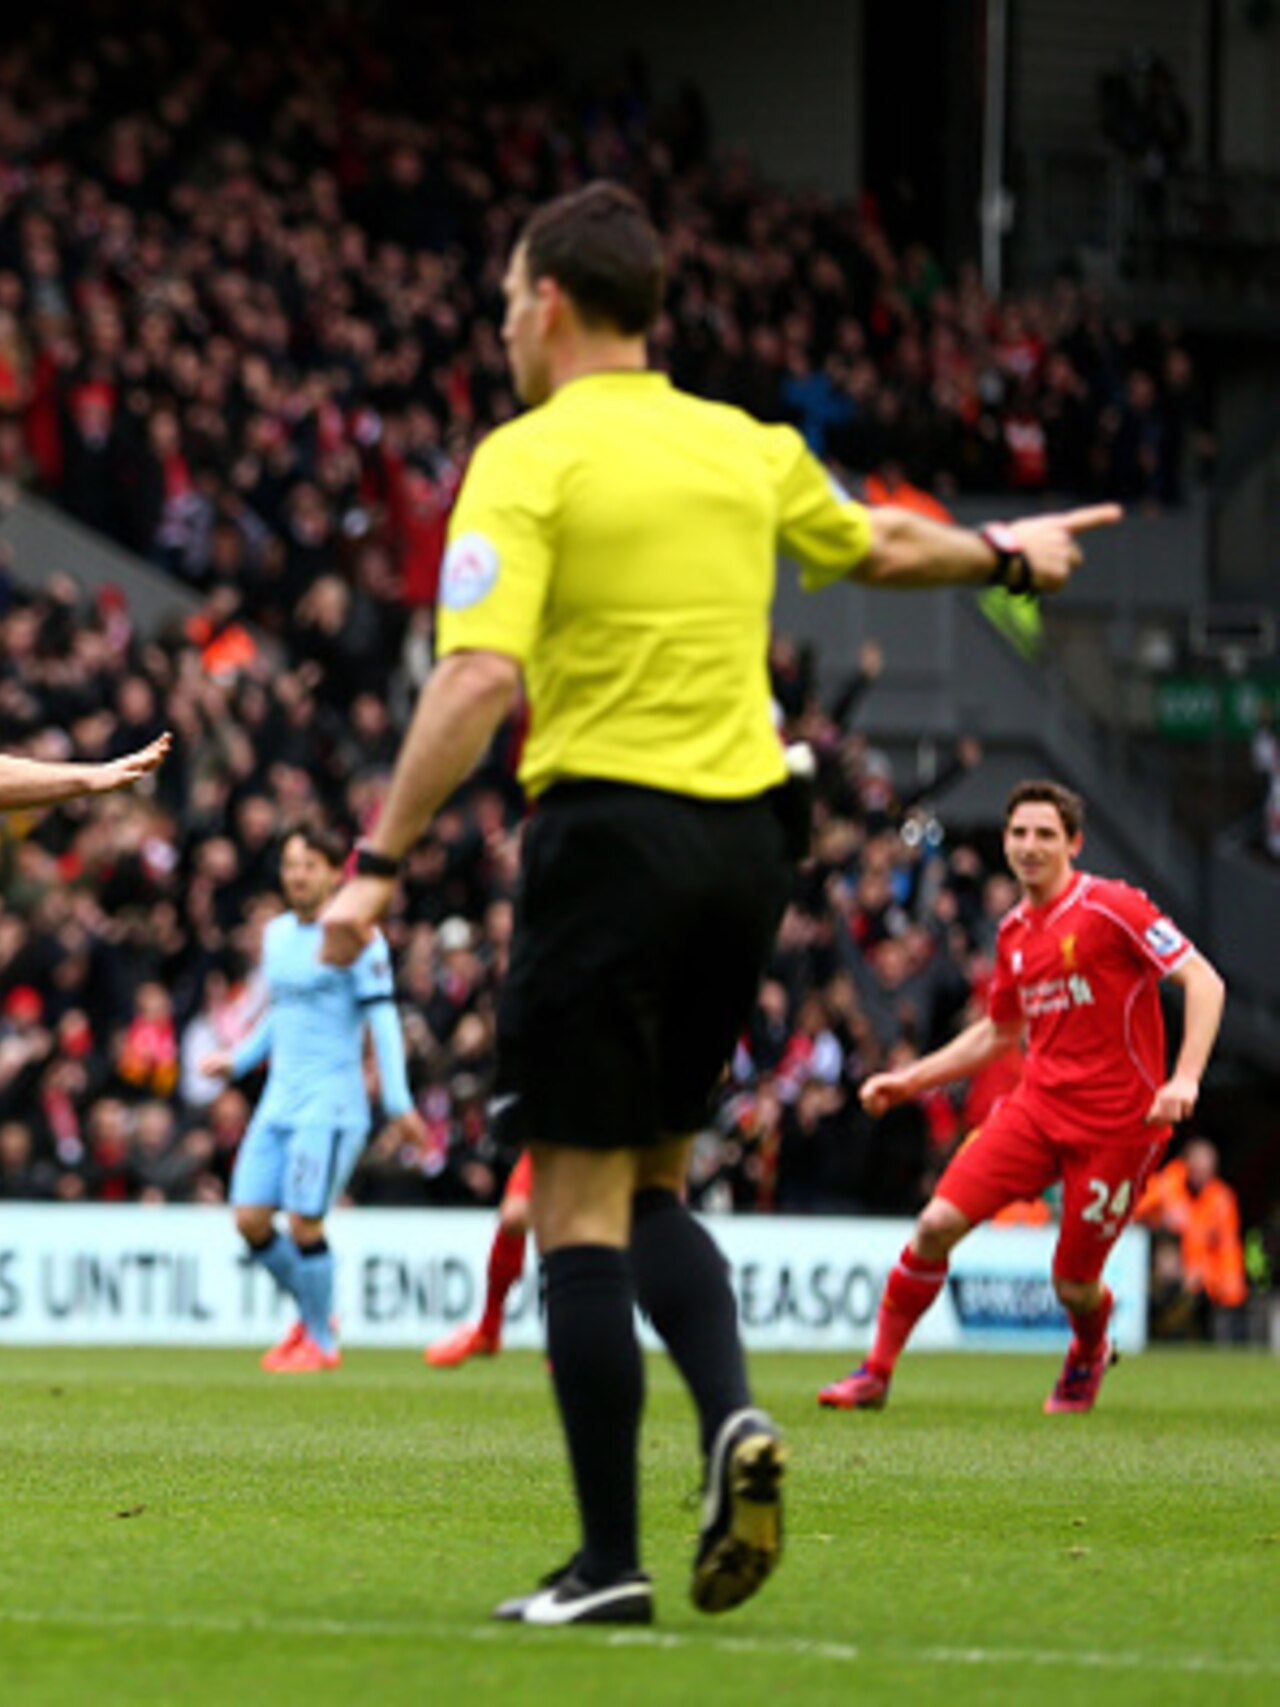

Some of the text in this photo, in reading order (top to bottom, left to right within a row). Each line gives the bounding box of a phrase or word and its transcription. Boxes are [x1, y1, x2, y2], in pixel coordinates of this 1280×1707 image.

[1081, 1179, 1131, 1222] 24
[42, 1250, 213, 1320] UNTIL
[363, 1253, 471, 1322] END
[740, 1263, 883, 1329] EASO
